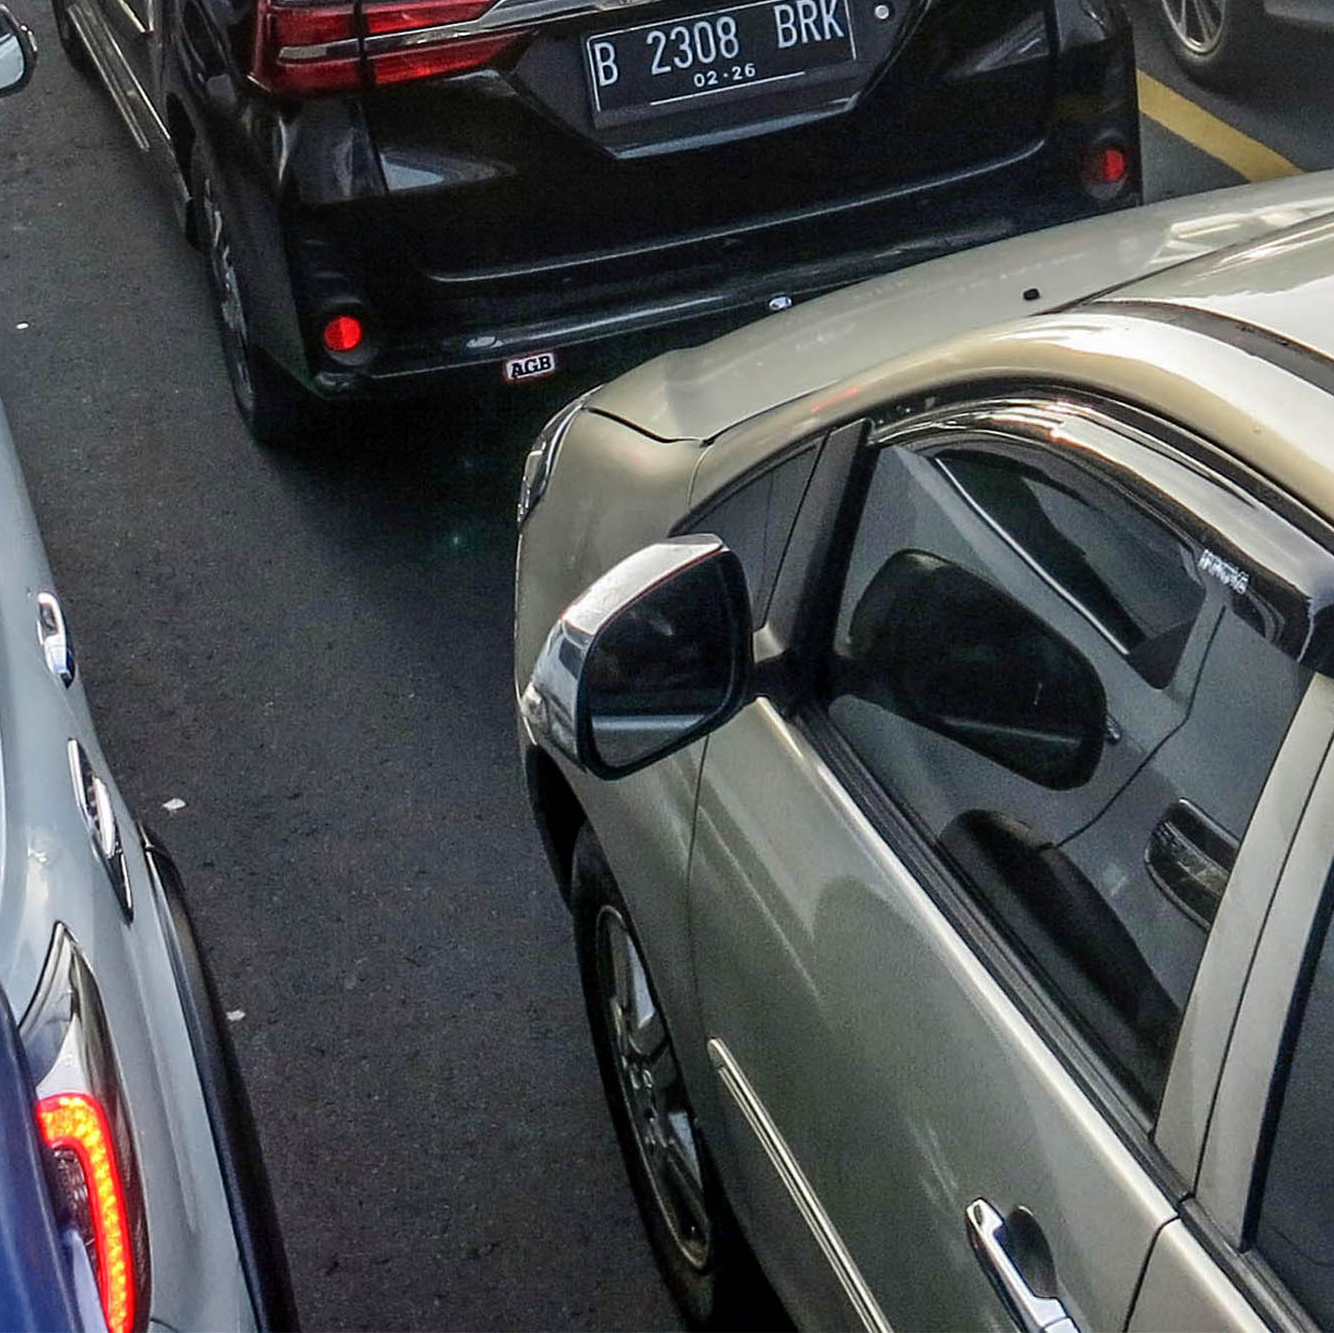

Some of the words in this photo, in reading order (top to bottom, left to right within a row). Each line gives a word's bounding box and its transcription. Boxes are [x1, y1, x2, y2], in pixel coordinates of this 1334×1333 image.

[594, 41, 618, 87] B
[646, 16, 740, 76] 2308
[511, 356, 552, 378] AGB
